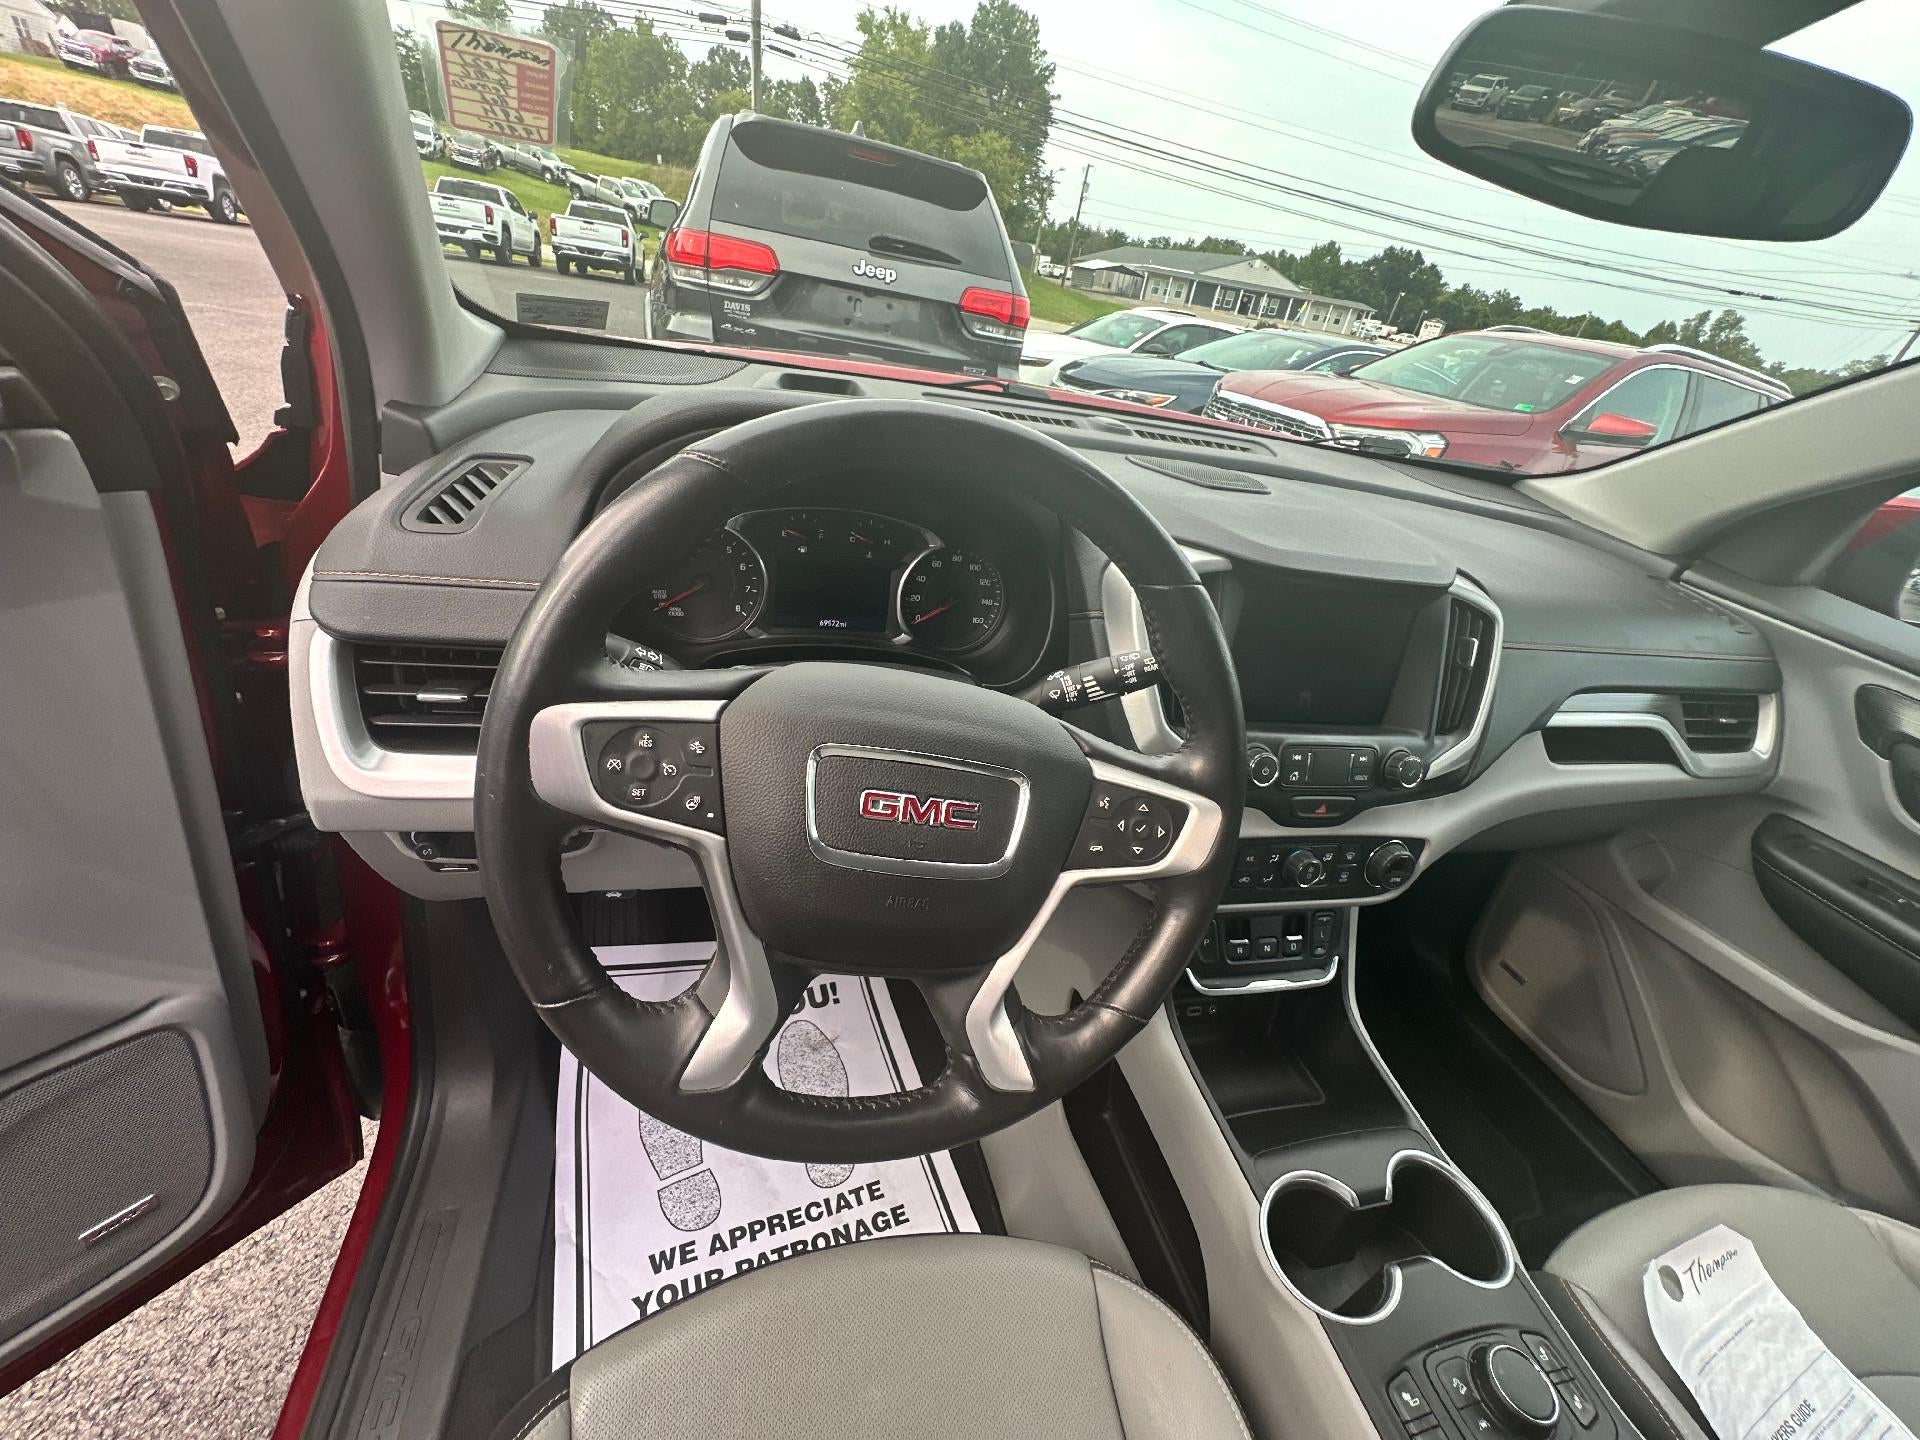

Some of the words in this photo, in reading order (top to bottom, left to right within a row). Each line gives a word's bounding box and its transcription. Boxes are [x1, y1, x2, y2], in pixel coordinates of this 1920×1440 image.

[851, 259, 897, 284] Jeep
[724, 300, 751, 312] DAVIS
[739, 563, 746, 571] 6
[931, 560, 942, 568] 60
[969, 563, 982, 571] 100
[916, 575, 926, 583] 40
[979, 578, 991, 586] 120
[744, 585, 751, 593] 7
[910, 594, 921, 602] 20
[1143, 663, 1159, 673] REAR
[638, 739, 653, 748] RES
[631, 788, 646, 797] SET
[859, 788, 981, 831] GMC
[1203, 938, 1210, 946] P
[1290, 942, 1297, 951] D
[1264, 944, 1271, 952] N
[648, 1240, 699, 1276] WE
[708, 1179, 886, 1257] APPRECIATE
[1682, 1249, 1738, 1296] Thompson
[1790, 1398, 1816, 1427] GUIDE
